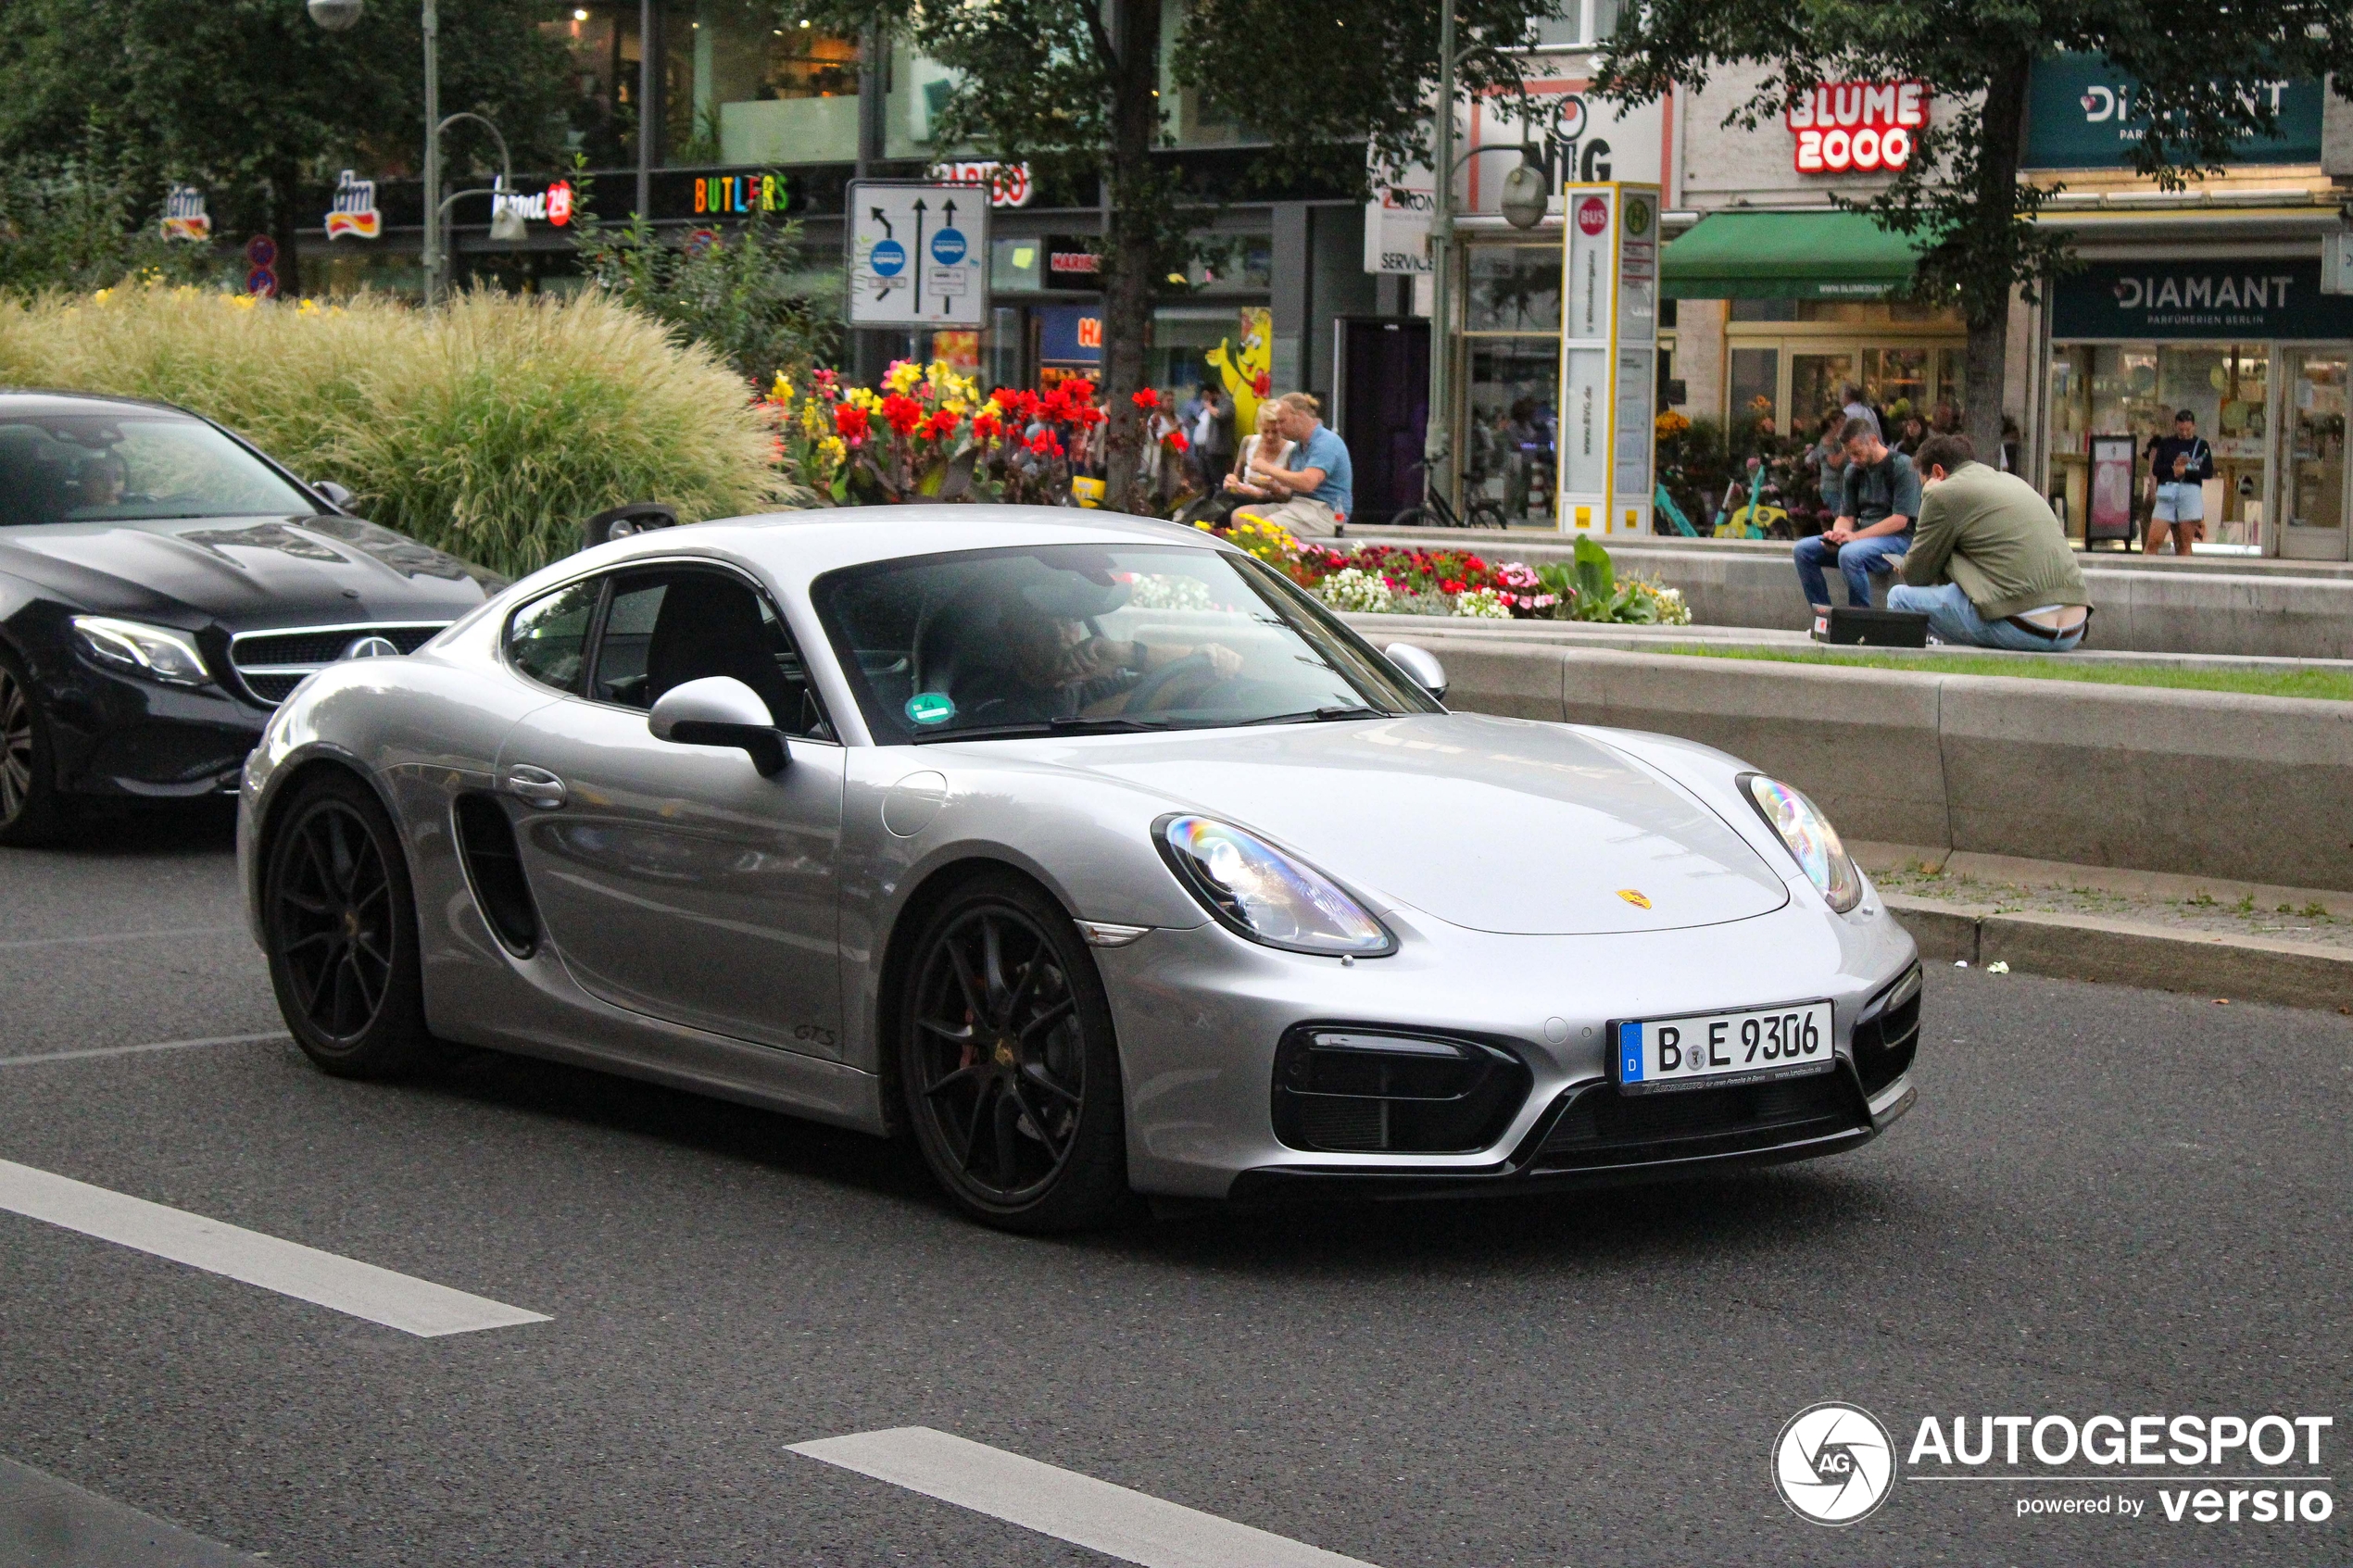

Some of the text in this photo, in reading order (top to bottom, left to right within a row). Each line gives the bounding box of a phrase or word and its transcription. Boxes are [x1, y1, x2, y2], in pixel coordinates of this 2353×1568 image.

[1790, 83, 1923, 128] BLUME
[1798, 127, 1911, 169] 2000
[694, 175, 788, 213] BUTLERS
[1580, 209, 1605, 225] BUS
[2118, 276, 2295, 308] DIAMANT
[2225, 314, 2264, 325] BERLIN
[794, 1024, 836, 1047] GTS
[1628, 1059, 1637, 1072] D
[1658, 1026, 1682, 1072] B
